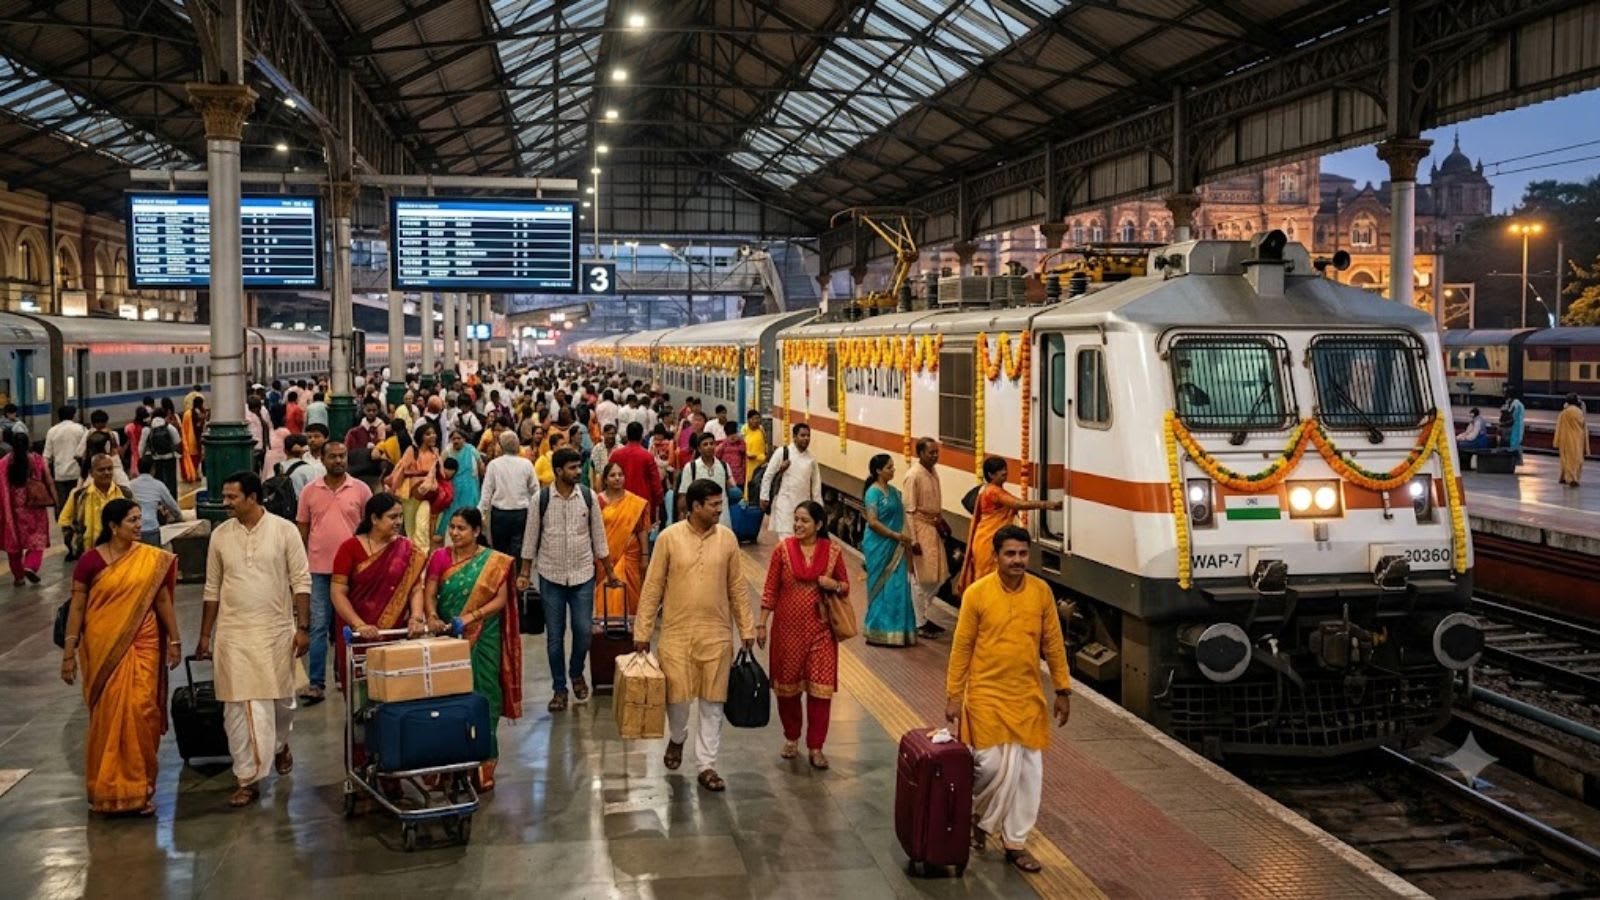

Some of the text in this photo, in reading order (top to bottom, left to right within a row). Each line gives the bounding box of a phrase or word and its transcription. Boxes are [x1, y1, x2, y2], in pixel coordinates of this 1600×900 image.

[589, 266, 609, 292] 3
[1191, 553, 1242, 569] WAP-7
[1404, 548, 1450, 563] 30360
